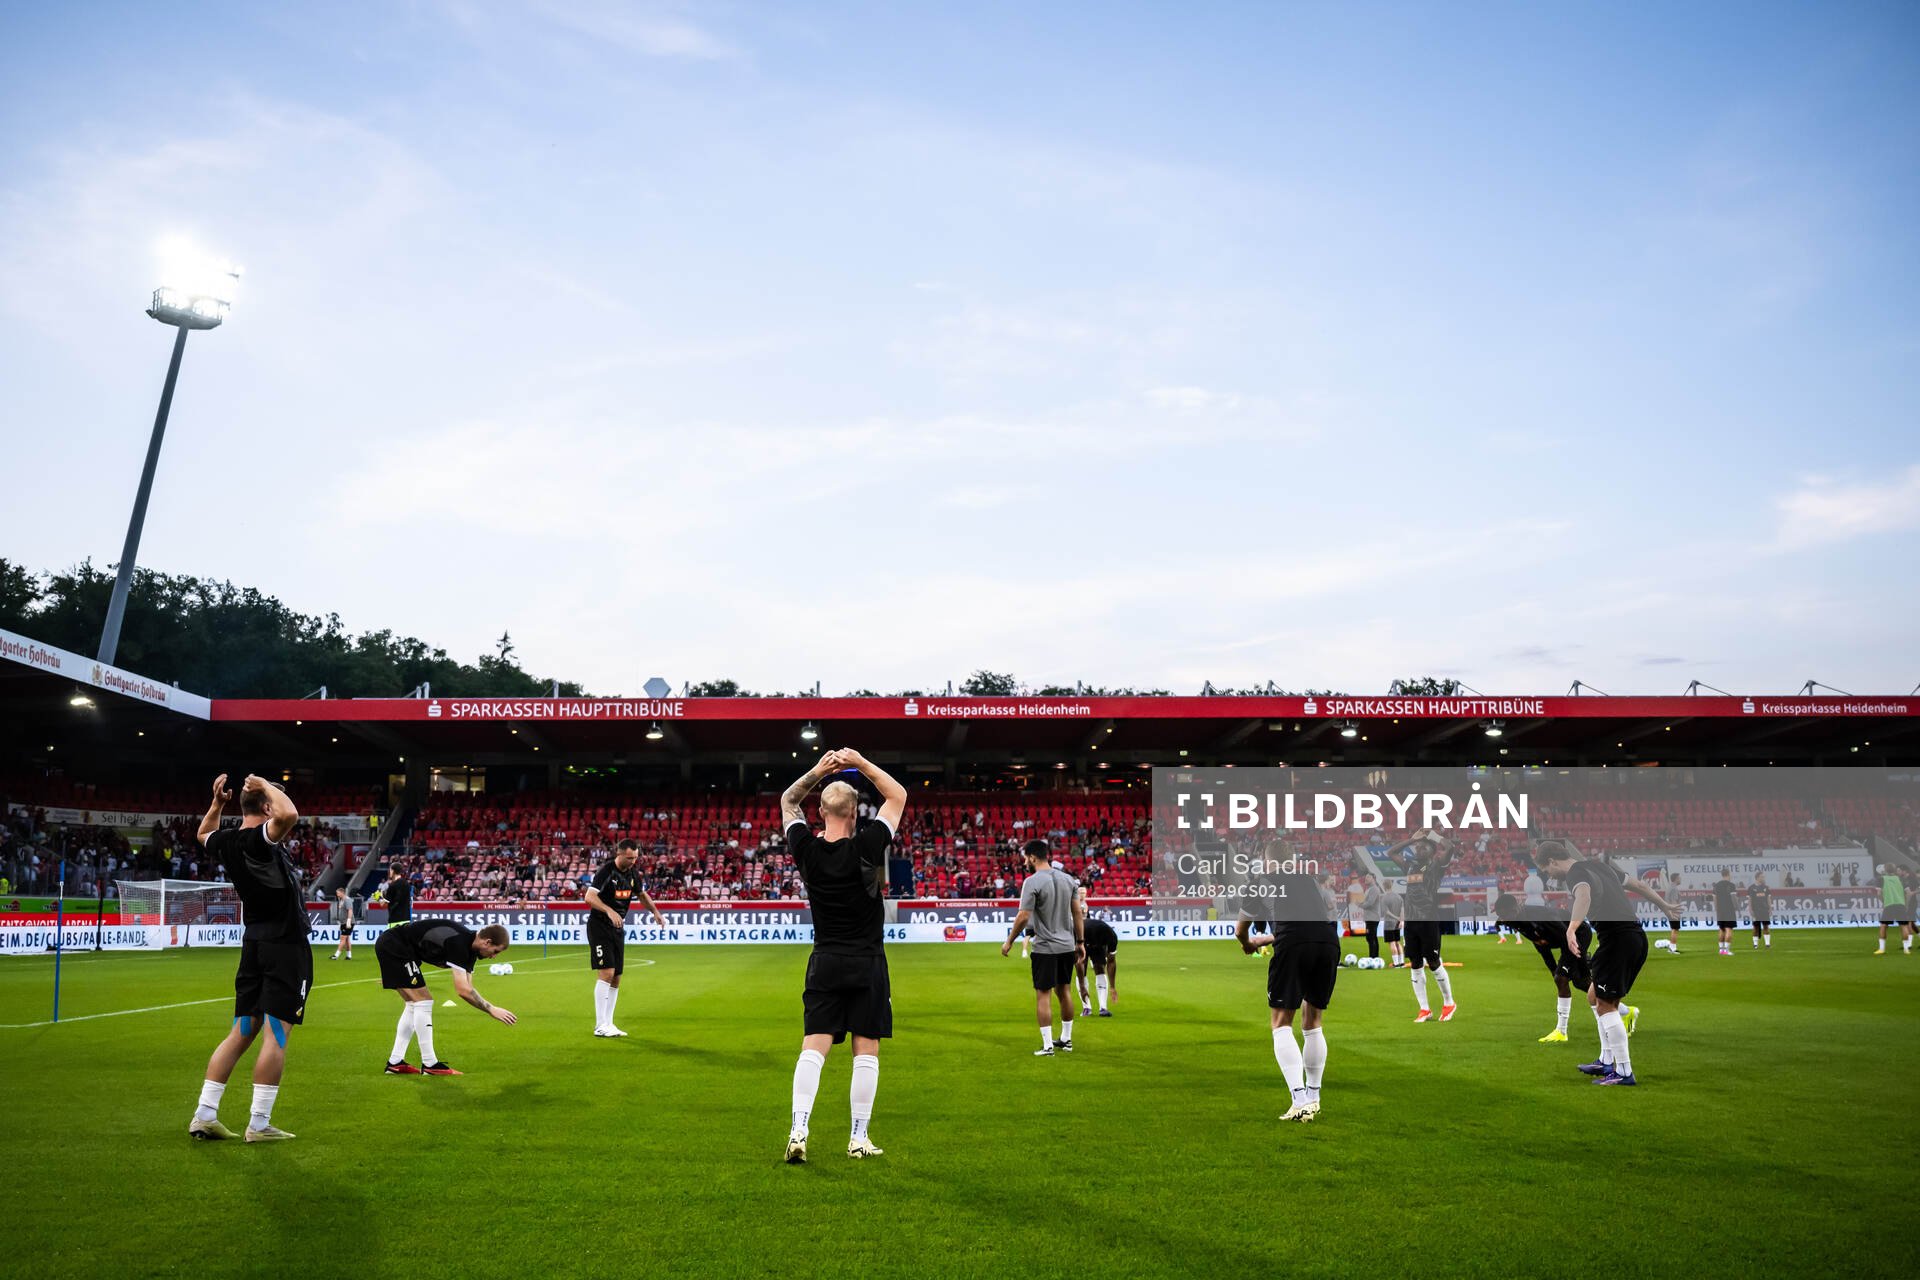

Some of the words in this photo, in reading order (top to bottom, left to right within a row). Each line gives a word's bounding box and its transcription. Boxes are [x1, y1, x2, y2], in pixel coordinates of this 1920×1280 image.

[451, 703, 553, 717] SPARKASSEN
[559, 701, 684, 717] HAUPTTRIBÜNE
[927, 703, 1015, 717] Kreissparkasse
[1019, 703, 1091, 715] Heidenheim
[1326, 700, 1424, 715] SPARKASSEN
[1429, 699, 1544, 715] HAUPTTRIBÜNE
[1763, 702, 1841, 715] Kreissparkasse
[1844, 702, 1907, 714] Heidenheim
[518, 914, 545, 925] SIE
[1640, 917, 1699, 928] WEREN
[198, 929, 225, 940] NICHTS
[312, 930, 359, 941] PAUE
[526, 929, 580, 941] BANDE
[624, 929, 679, 941] ASSEN
[701, 929, 803, 941] INSTAGRAM:
[1137, 925, 1165, 937] DER
[1173, 925, 1201, 936] FCH
[1209, 924, 1235, 936] KID
[596, 945, 603, 957] 5
[405, 961, 420, 977] 14
[301, 980, 307, 1000] 4
